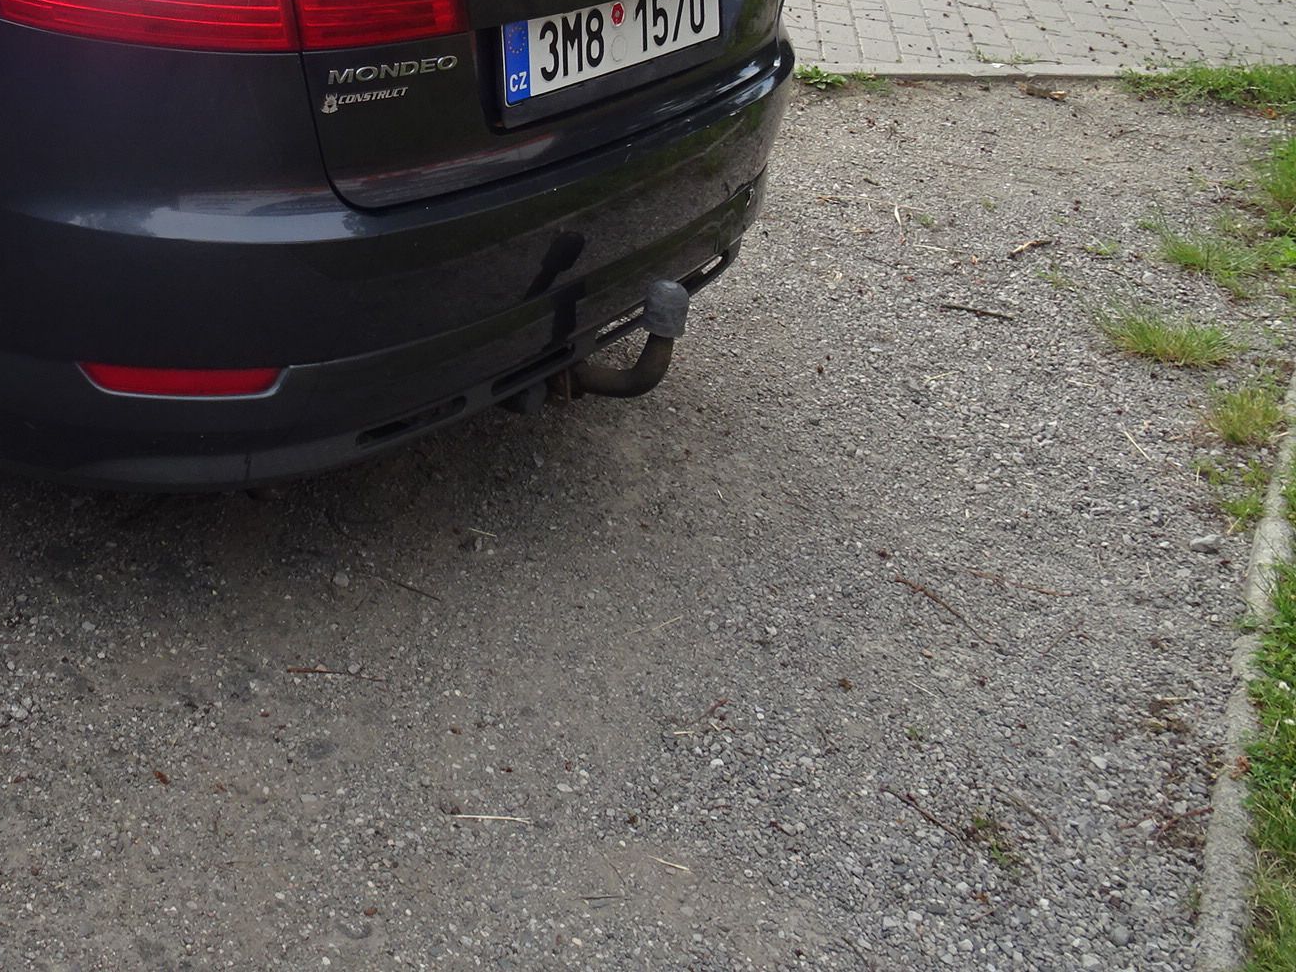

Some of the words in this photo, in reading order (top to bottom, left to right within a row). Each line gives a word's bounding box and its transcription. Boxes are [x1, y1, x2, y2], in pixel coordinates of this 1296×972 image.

[539, 8, 604, 82] 3M8
[327, 55, 458, 85] MONDEO
[509, 71, 528, 92] CZ
[337, 86, 408, 105] CONSTRUCT
